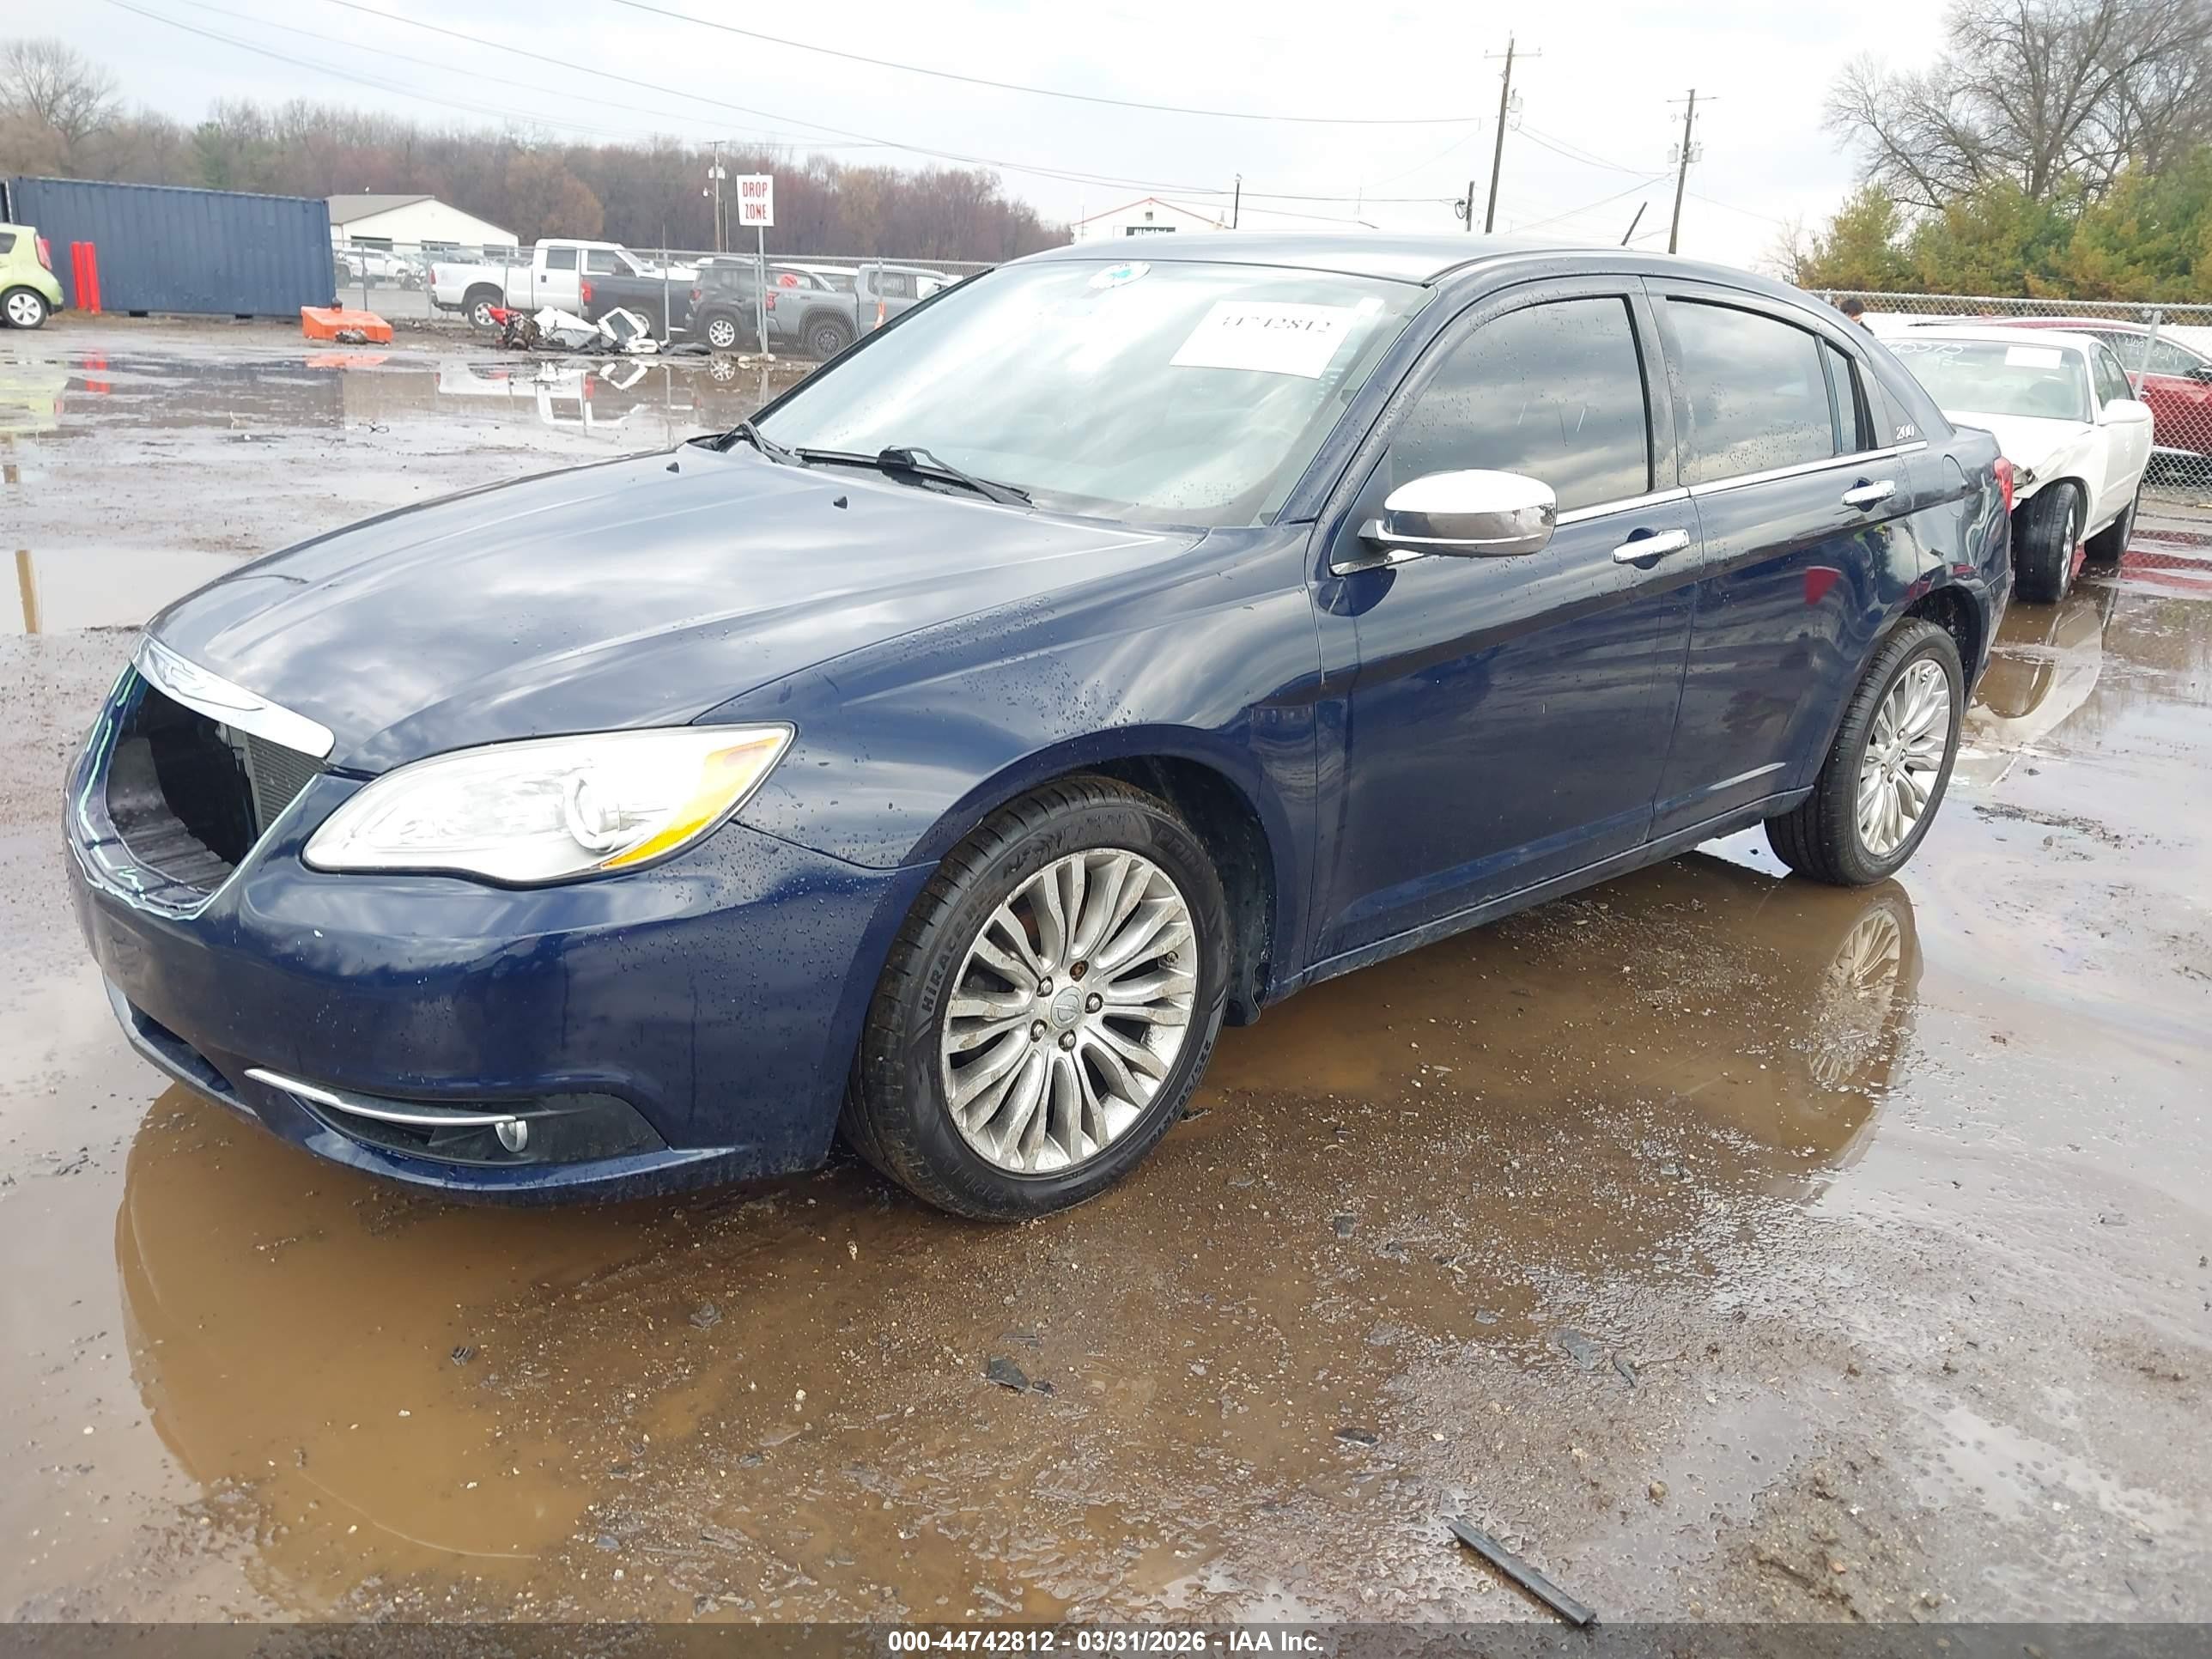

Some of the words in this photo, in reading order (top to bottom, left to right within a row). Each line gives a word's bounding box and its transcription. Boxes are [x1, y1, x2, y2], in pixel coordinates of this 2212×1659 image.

[742, 181, 768, 198] DROP
[744, 204, 767, 220] ZONE
[1896, 424, 1915, 441] 200
